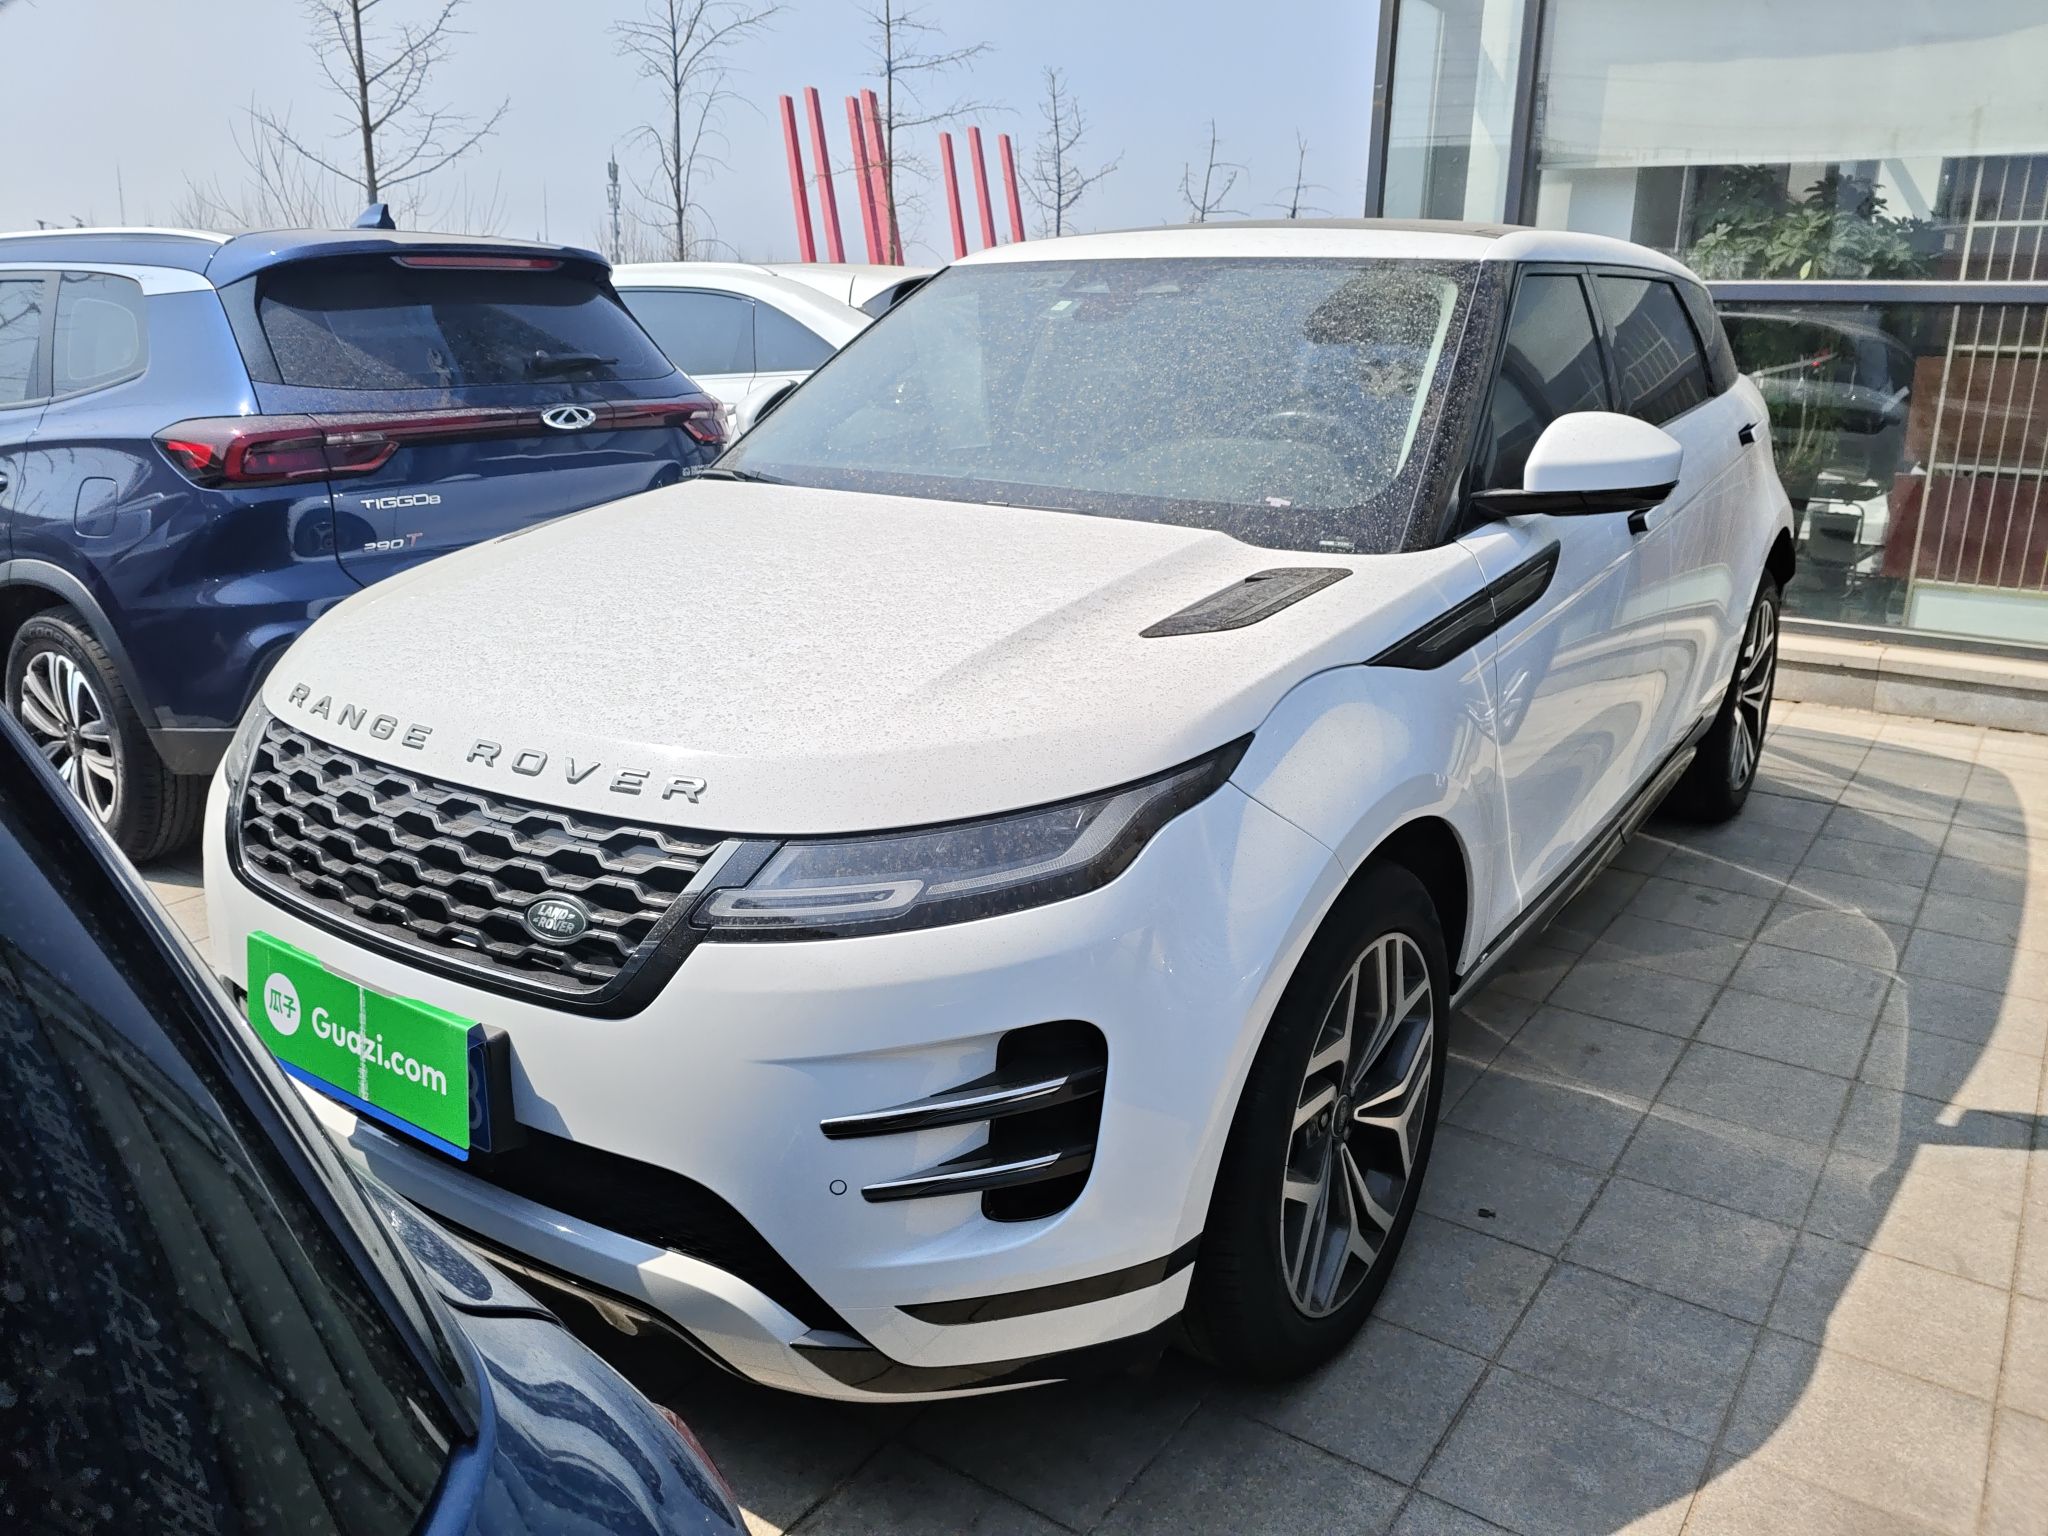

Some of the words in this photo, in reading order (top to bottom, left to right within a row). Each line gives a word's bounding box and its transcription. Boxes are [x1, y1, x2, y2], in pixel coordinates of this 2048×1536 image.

[288, 682, 434, 750] RANGE
[466, 738, 708, 804] ROVER
[537, 904, 569, 920] LAND
[537, 916, 575, 935] ROVER
[268, 987, 297, 1020] 瓜子
[311, 1006, 447, 1097] Guazi.com
